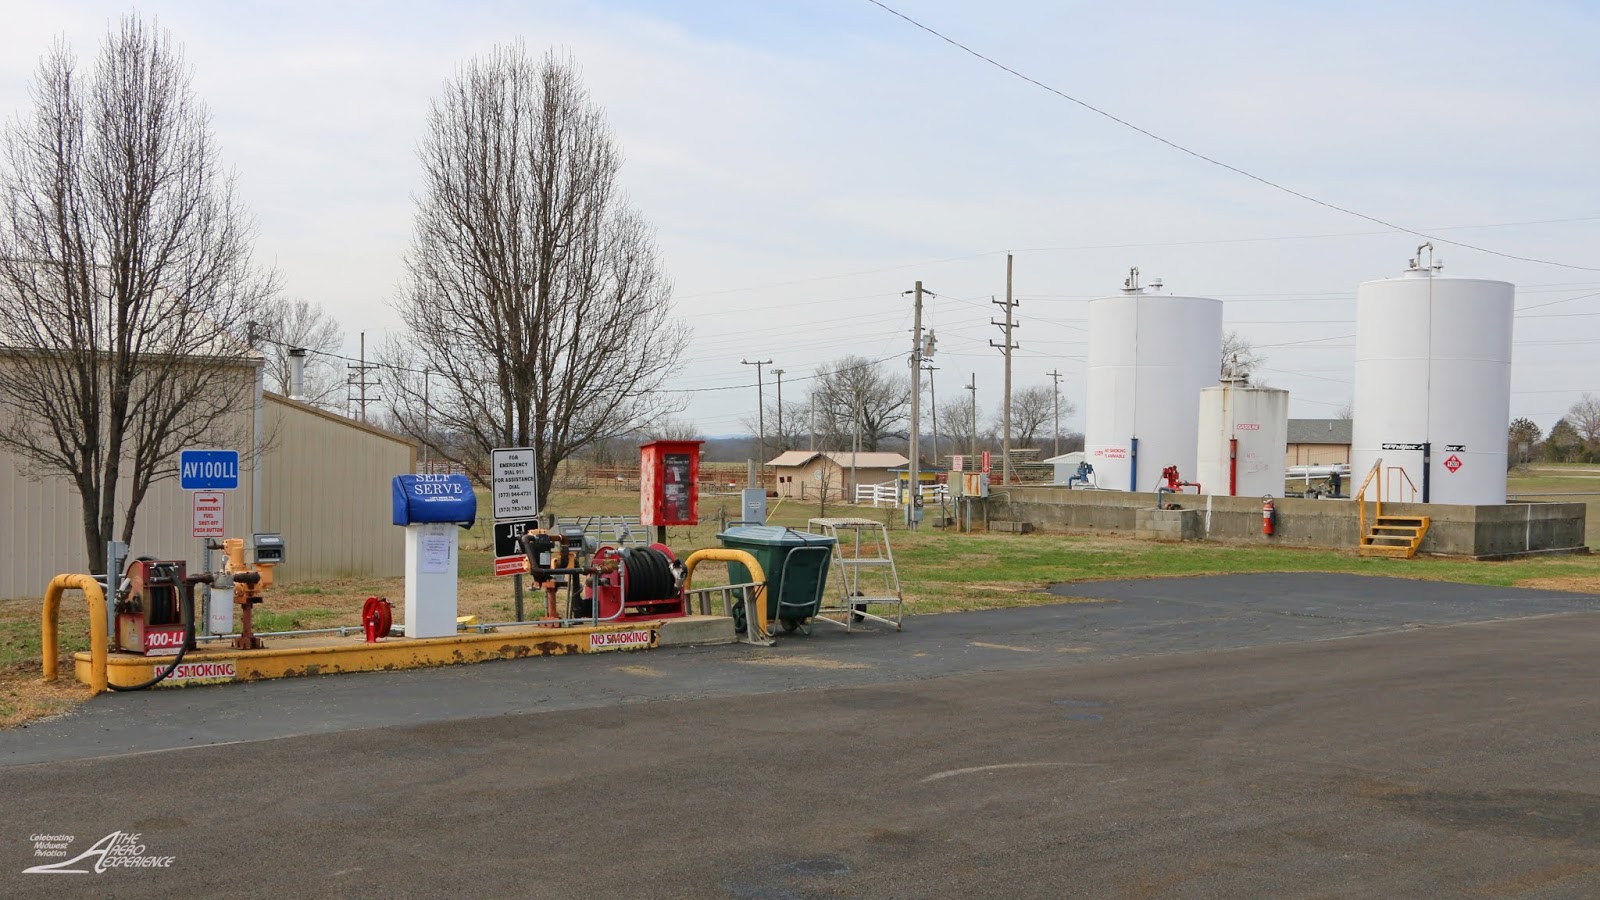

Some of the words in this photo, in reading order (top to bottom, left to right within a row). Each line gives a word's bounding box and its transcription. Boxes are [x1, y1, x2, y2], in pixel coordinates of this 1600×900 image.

[183, 462, 236, 478] AV100LL
[416, 474, 450, 482] SELF
[414, 483, 463, 495] SERVE
[507, 523, 526, 538] JET
[514, 540, 522, 554] A
[148, 631, 184, 647] 100-LL
[591, 634, 605, 645] NO
[606, 631, 648, 644] SMOKING
[177, 663, 235, 678] SMOKING
